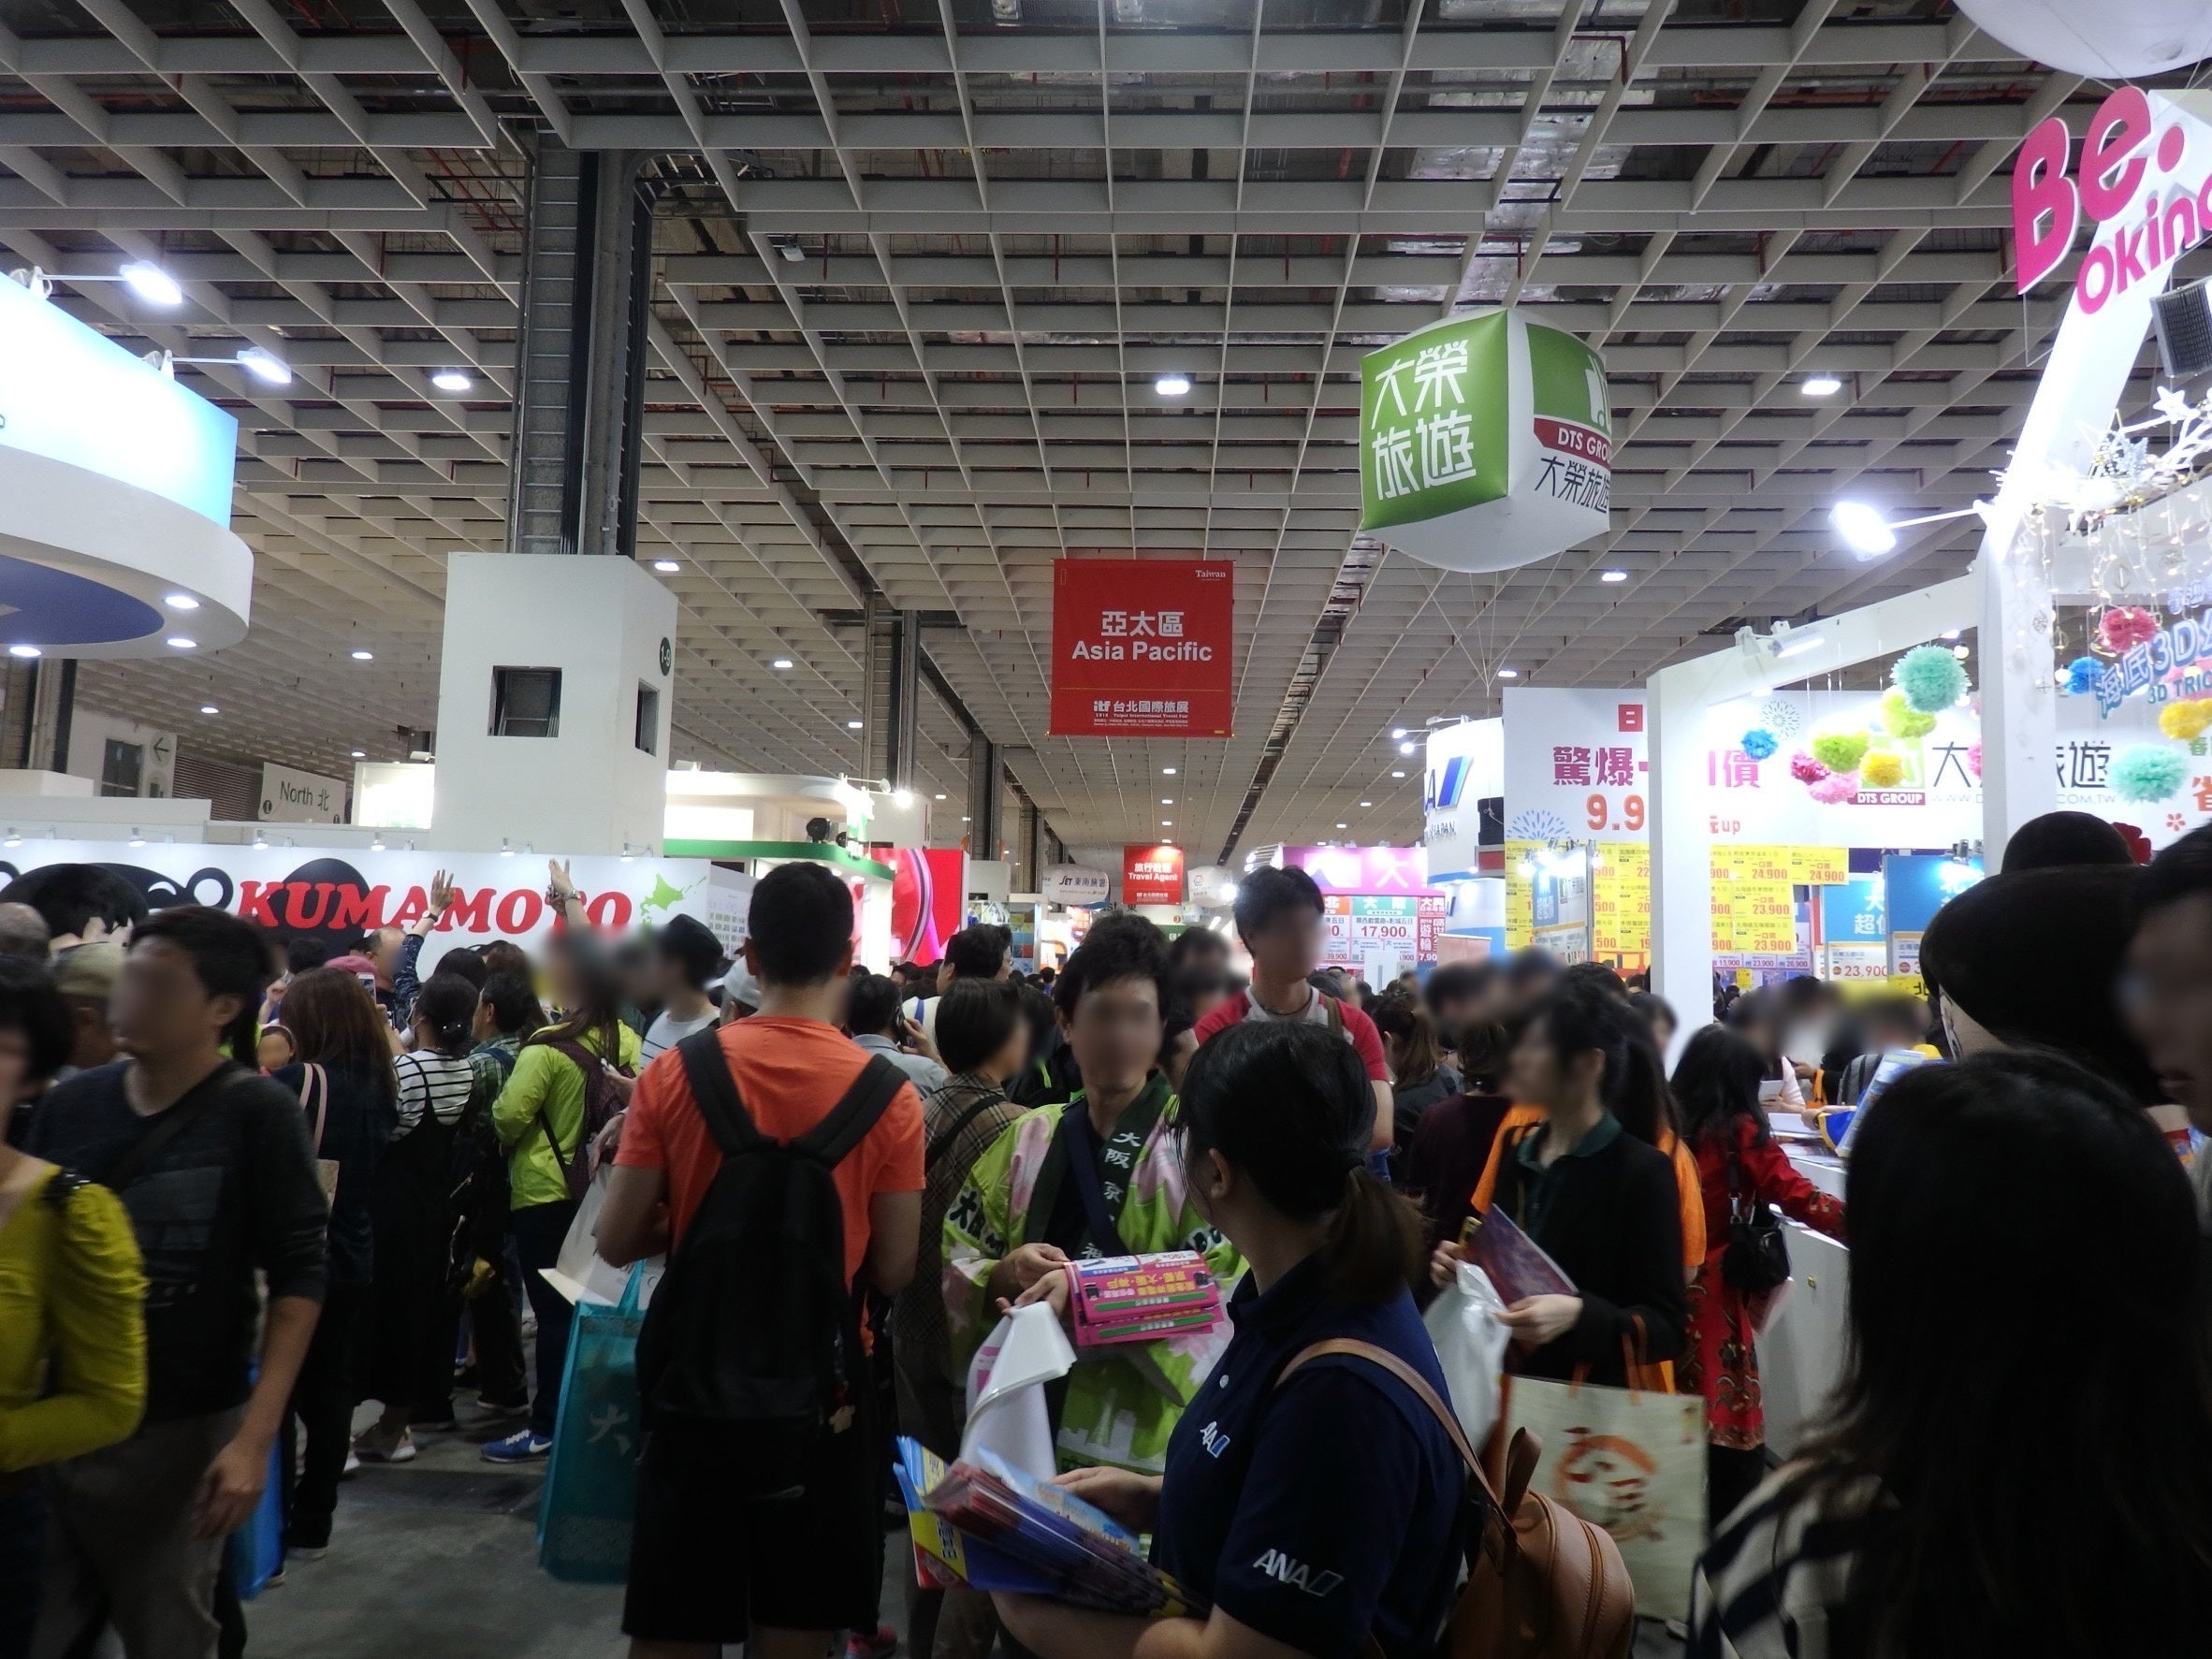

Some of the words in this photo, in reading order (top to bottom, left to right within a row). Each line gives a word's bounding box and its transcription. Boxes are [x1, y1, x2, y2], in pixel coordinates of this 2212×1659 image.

[2012, 85, 2185, 296] Be.
[2076, 174, 2212, 315] okin
[1558, 427, 1583, 451] DTS
[1372, 410, 1477, 501] 旅遊
[1195, 570, 1226, 578] Taiwan
[1100, 610, 1185, 637] 亞太區
[1071, 640, 1124, 661] Asia
[1132, 641, 1213, 662] Pacific
[1113, 700, 1189, 713] 台北國際旅展
[280, 780, 313, 807] North
[317, 788, 330, 812] 北
[1857, 793, 1878, 805] DTS
[1880, 792, 1923, 805] GROUP
[1154, 873, 1178, 882] Agent
[1252, 1548, 1312, 1593] ANA
